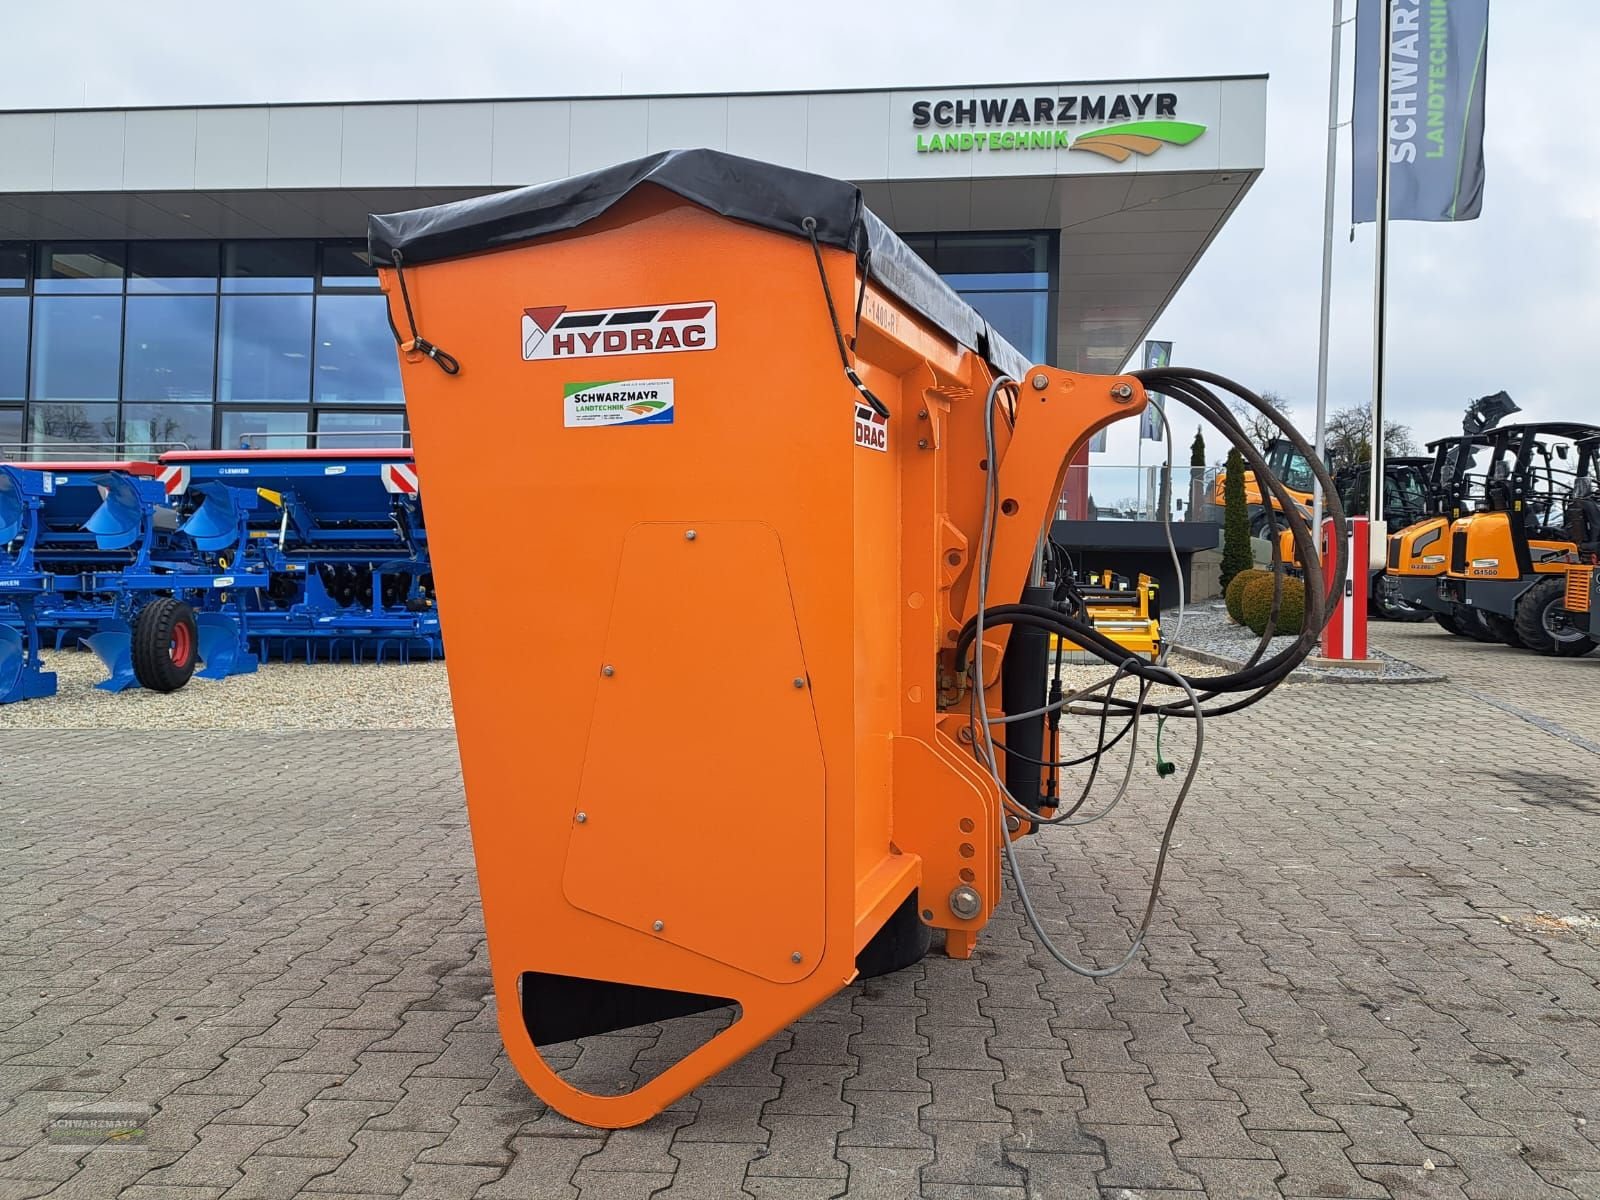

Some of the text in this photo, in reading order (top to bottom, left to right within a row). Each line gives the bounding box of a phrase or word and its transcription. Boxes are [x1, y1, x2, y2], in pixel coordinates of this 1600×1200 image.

[1389, 0, 1420, 164] SCHWAR
[912, 93, 1178, 128] SCHWARZMAYR
[917, 130, 1068, 152] LANDTECHNIK
[553, 325, 705, 355] HYDRAC
[574, 391, 658, 403] SCHWARZMAYR
[576, 404, 624, 412] LANDTECHNIK
